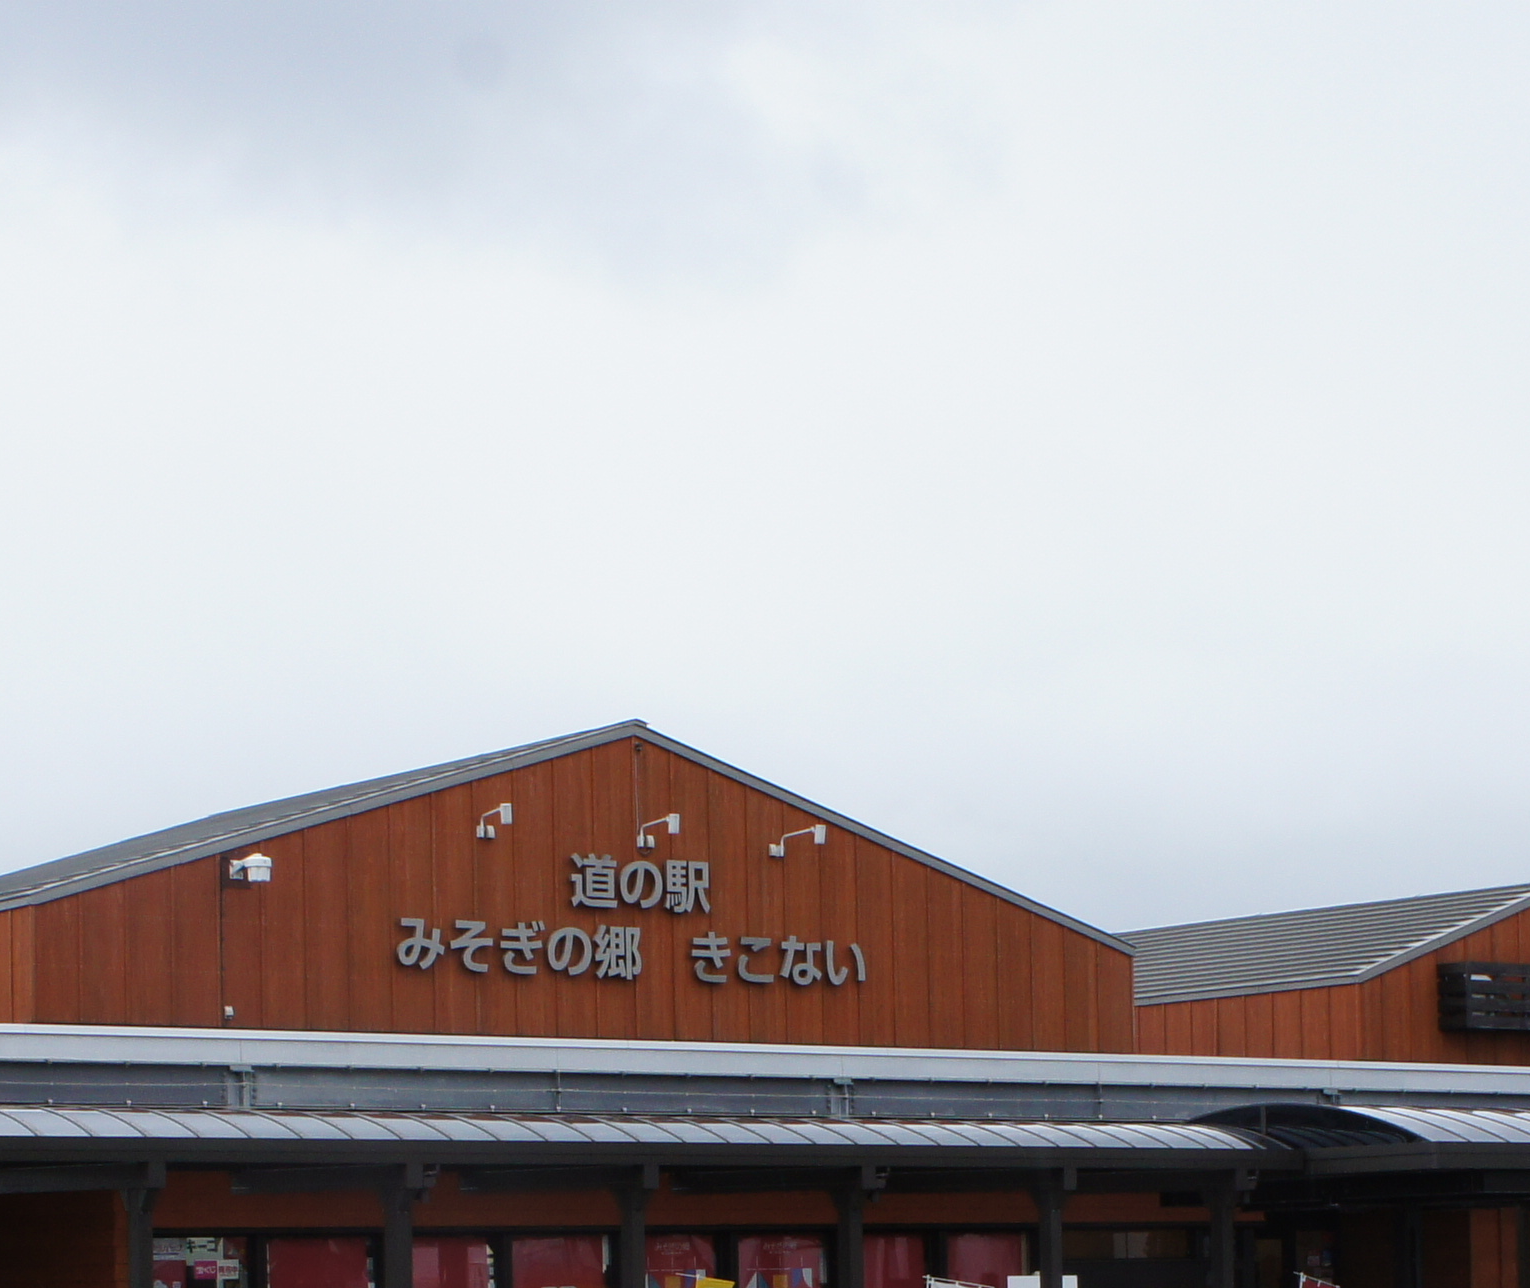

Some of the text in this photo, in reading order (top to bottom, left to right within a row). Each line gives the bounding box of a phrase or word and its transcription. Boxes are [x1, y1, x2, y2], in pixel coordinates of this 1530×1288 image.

[570, 853, 711, 913] 道の駅
[396, 917, 867, 986] みそぎの郷 きこない
